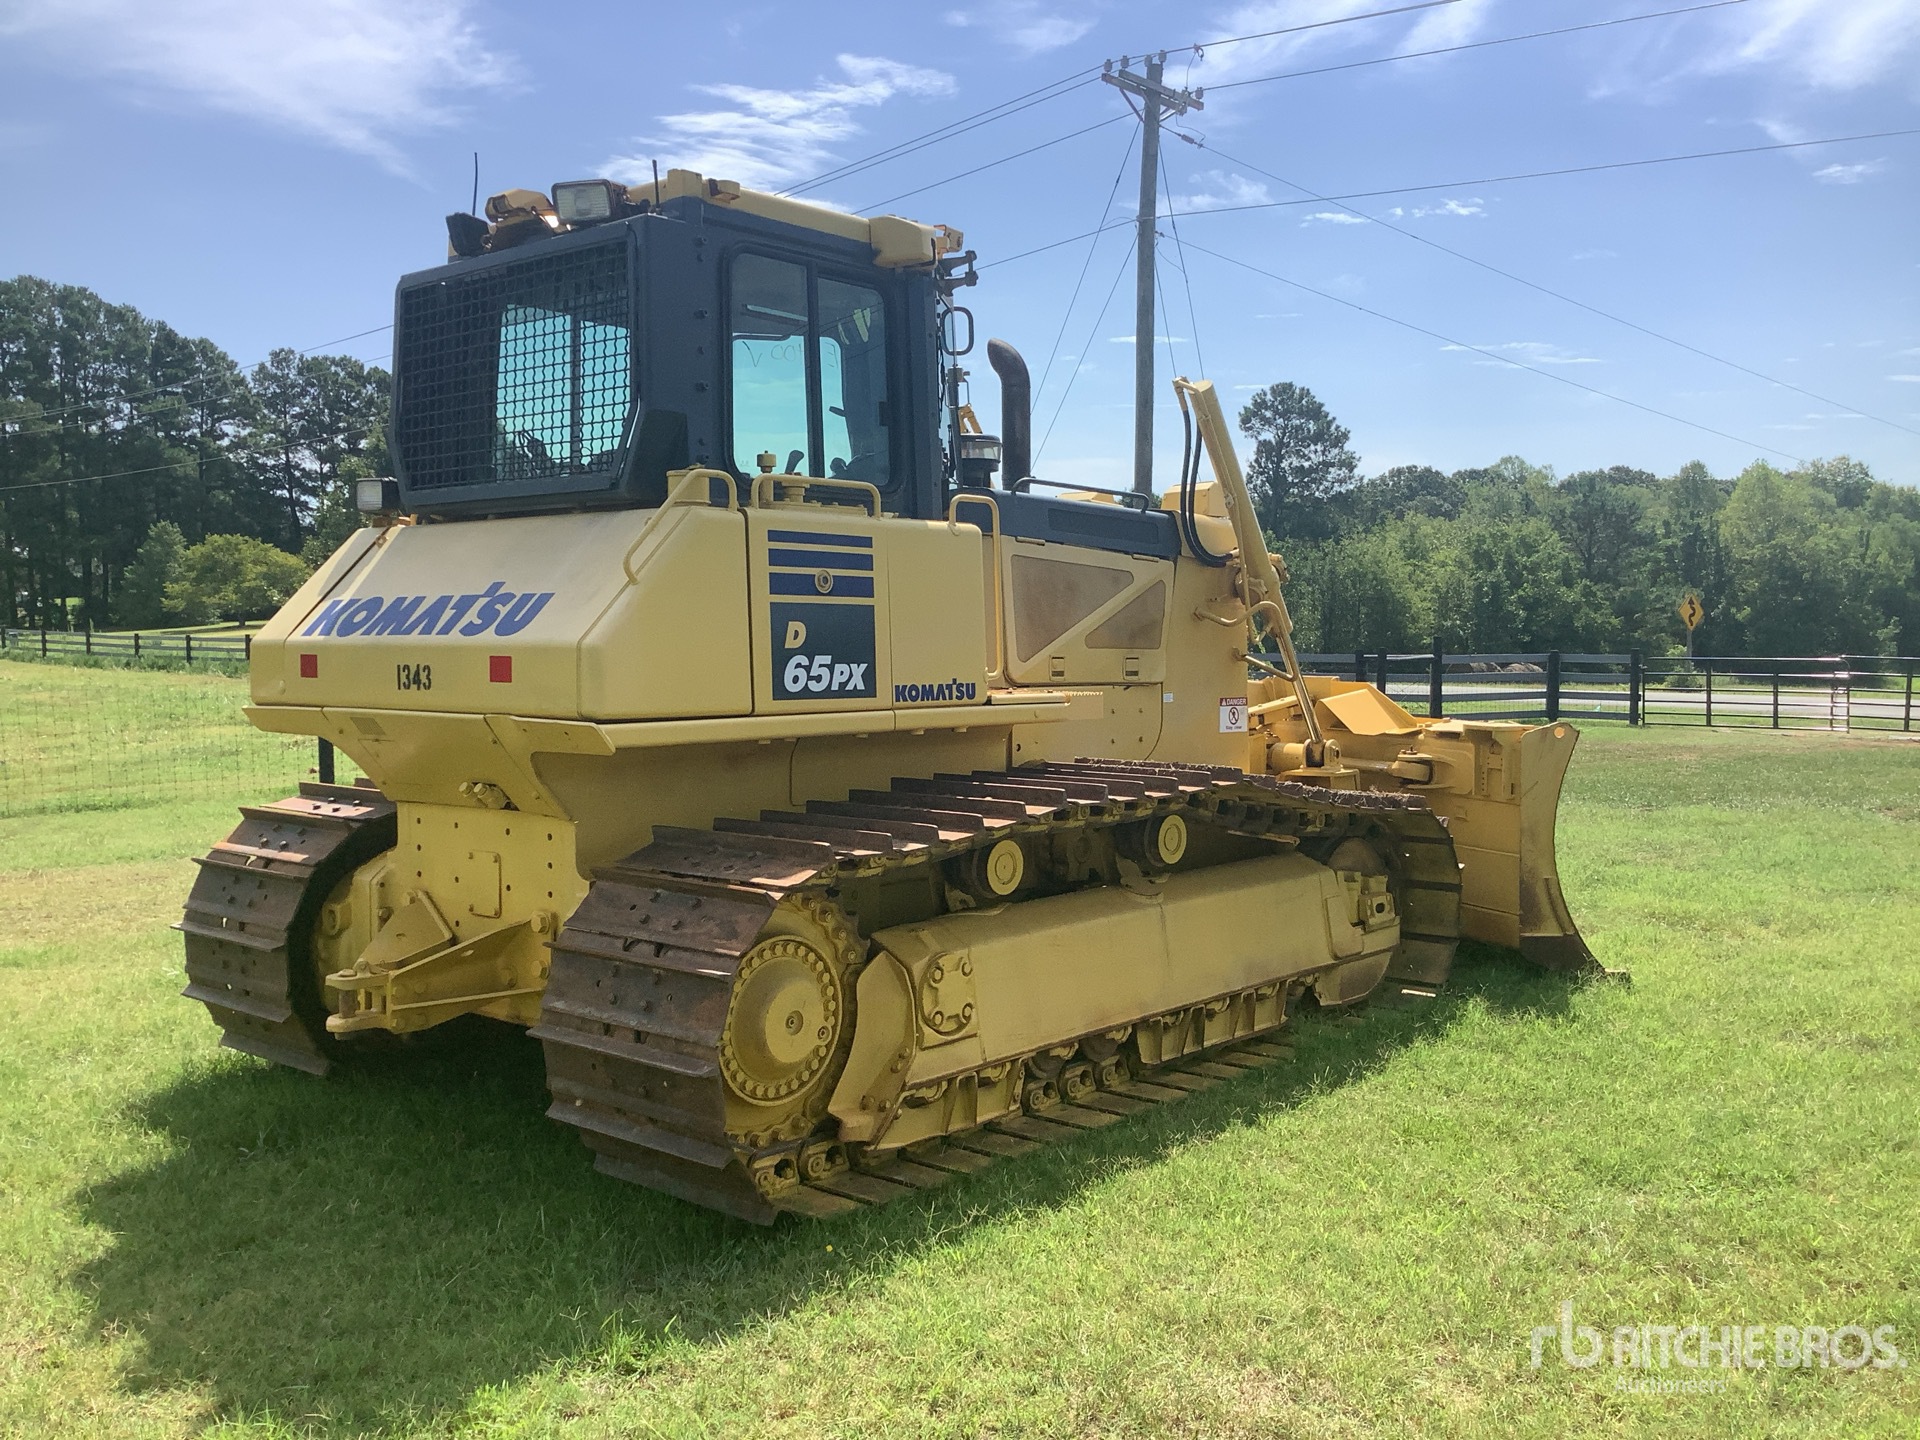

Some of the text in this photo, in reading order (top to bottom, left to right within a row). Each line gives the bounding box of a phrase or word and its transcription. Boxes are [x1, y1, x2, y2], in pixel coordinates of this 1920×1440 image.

[301, 581, 555, 637] KOMATSU
[784, 621, 807, 649] D
[396, 664, 432, 691] 1343
[783, 654, 868, 693] 65PX
[894, 678, 976, 703] KOMATSU
[1226, 698, 1246, 706] DANGER
